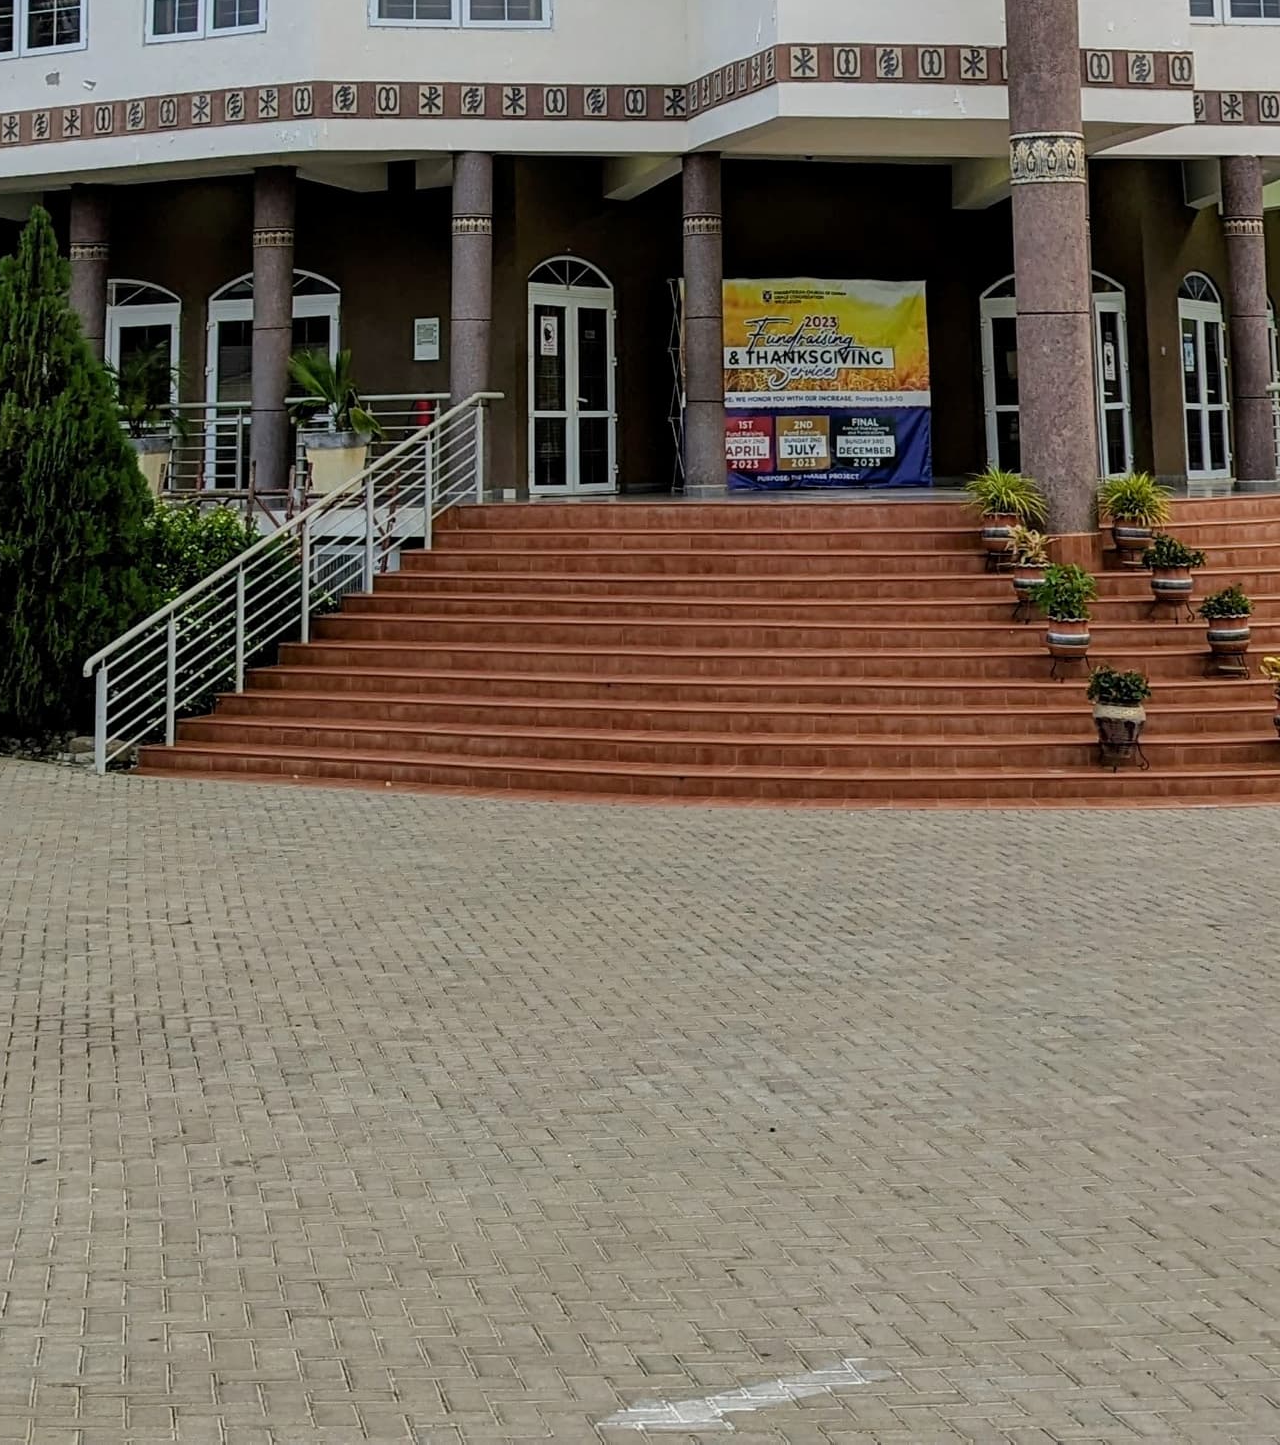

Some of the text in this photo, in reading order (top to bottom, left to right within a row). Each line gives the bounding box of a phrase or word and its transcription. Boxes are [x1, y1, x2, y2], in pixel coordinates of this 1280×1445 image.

[804, 316, 837, 328] 2023
[745, 317, 864, 353] Fundraising
[729, 350, 884, 365] & THANKSGIVING
[769, 357, 836, 387] Services
[738, 420, 754, 429] 1ST
[793, 420, 813, 429] 2ND
[851, 418, 879, 427] FINAL
[839, 447, 892, 455] DECEMBER
[731, 460, 759, 469] 2023
[791, 458, 816, 467] 2023
[853, 458, 881, 467] 2023
